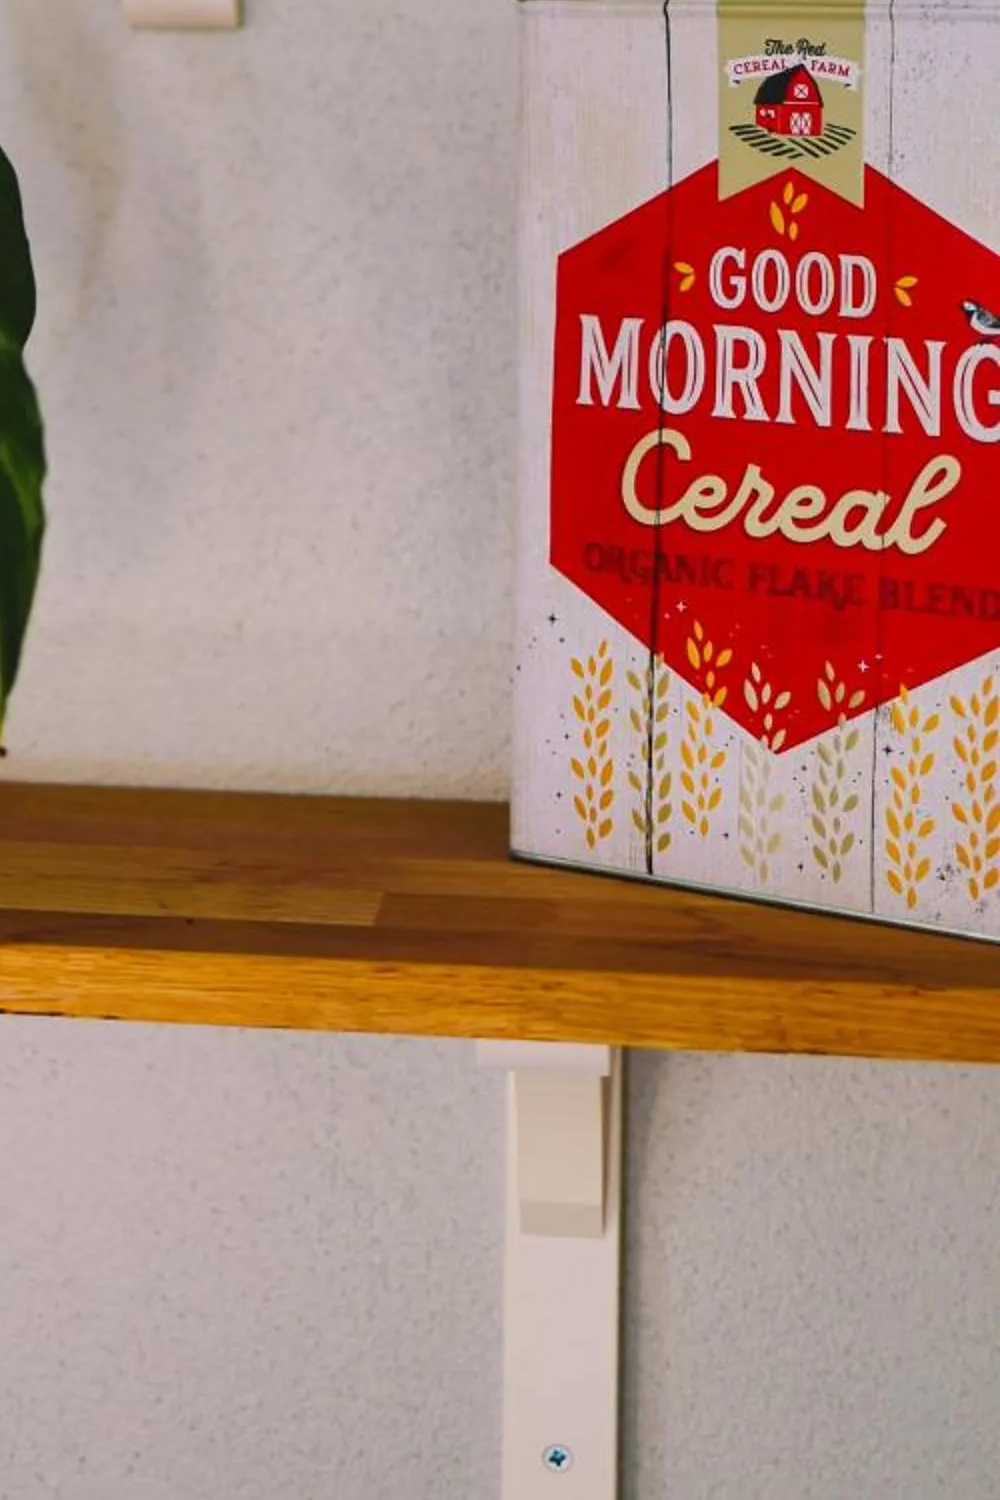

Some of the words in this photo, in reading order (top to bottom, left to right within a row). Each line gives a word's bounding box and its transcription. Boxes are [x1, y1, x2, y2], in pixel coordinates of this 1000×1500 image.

[733, 58, 788, 76] CEREAL
[810, 59, 851, 78] FARM
[764, 38, 795, 57] The
[796, 37, 826, 60] Red
[708, 245, 878, 319] GOOD
[575, 313, 1000, 444] MORNING
[620, 427, 962, 556] Cereal
[582, 541, 737, 592] ORGANIC
[747, 562, 868, 611] FLAKE
[878, 576, 1000, 623] BLEND
